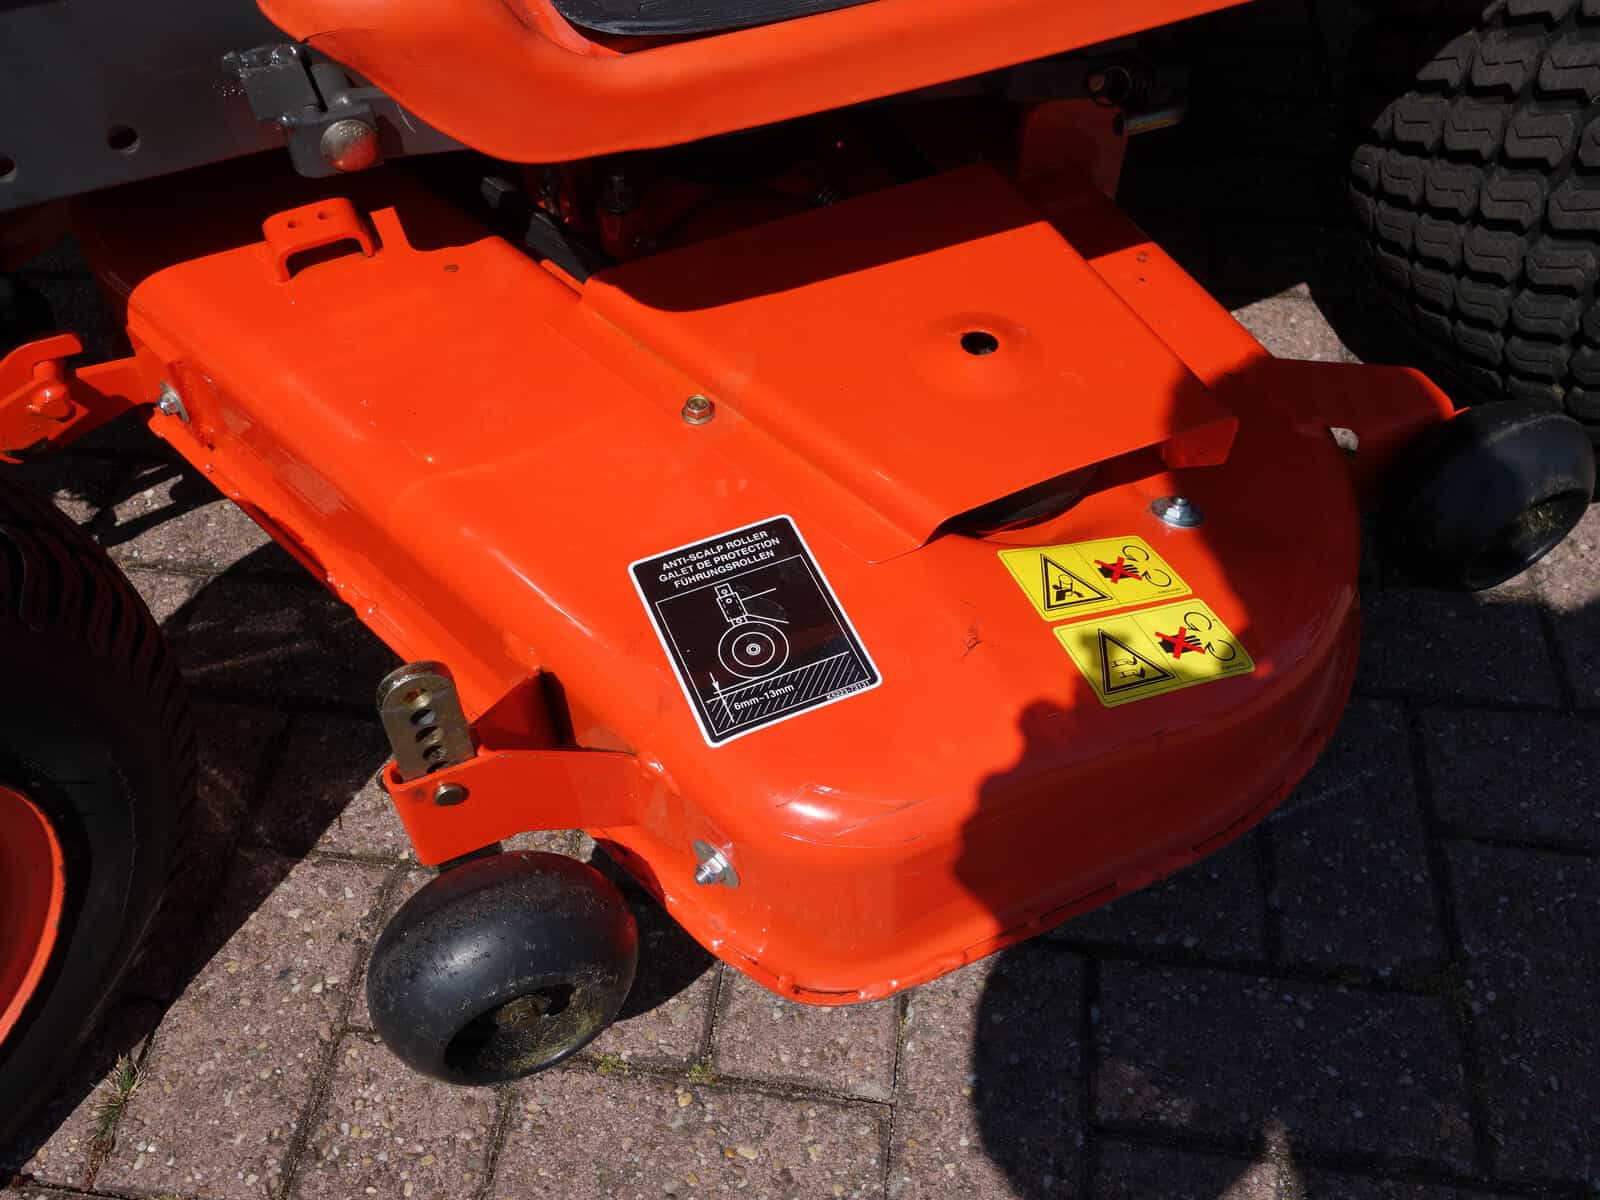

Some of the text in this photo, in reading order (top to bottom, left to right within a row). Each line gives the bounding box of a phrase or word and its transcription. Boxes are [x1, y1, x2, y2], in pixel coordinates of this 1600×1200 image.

[658, 537, 781, 582] GALET DE PROTECTION
[662, 530, 769, 571] ANTI-SCALP ROLLER
[673, 550, 775, 588] FÜHRUNGSROLLEN
